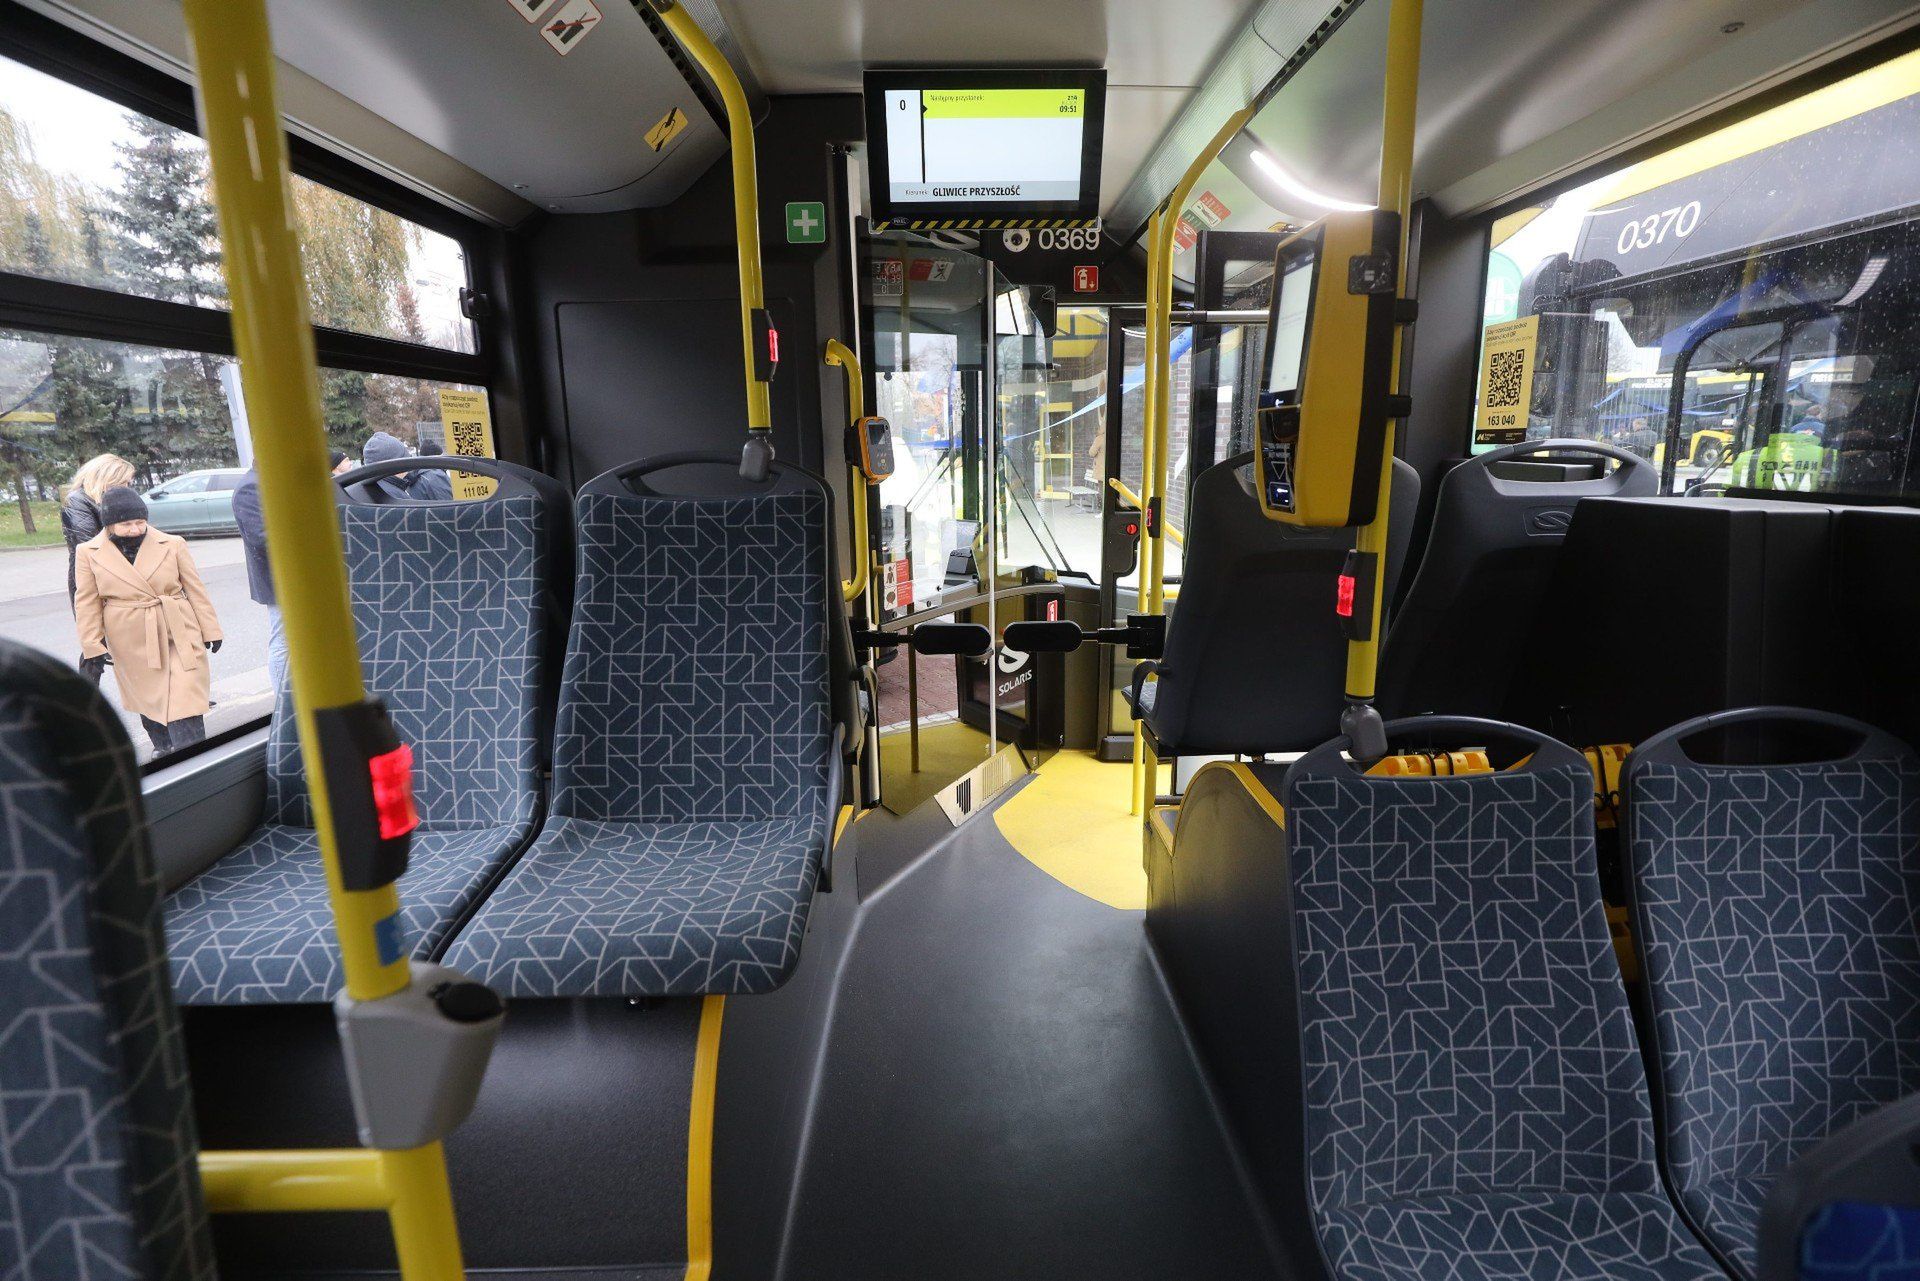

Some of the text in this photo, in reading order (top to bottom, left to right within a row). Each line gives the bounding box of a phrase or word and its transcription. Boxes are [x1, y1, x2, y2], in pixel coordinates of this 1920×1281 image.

[899, 99, 906, 111] 0
[1059, 105, 1077, 113] 09:51
[932, 187, 968, 197] GLIWICE
[969, 184, 1021, 196] PRZYSZŁOŚĆ
[1617, 200, 1701, 255] 0370
[1038, 228, 1100, 251] 0369
[1487, 414, 1516, 426] 163 040
[463, 485, 489, 498] 111 034
[998, 669, 1033, 697] SOLARIS
